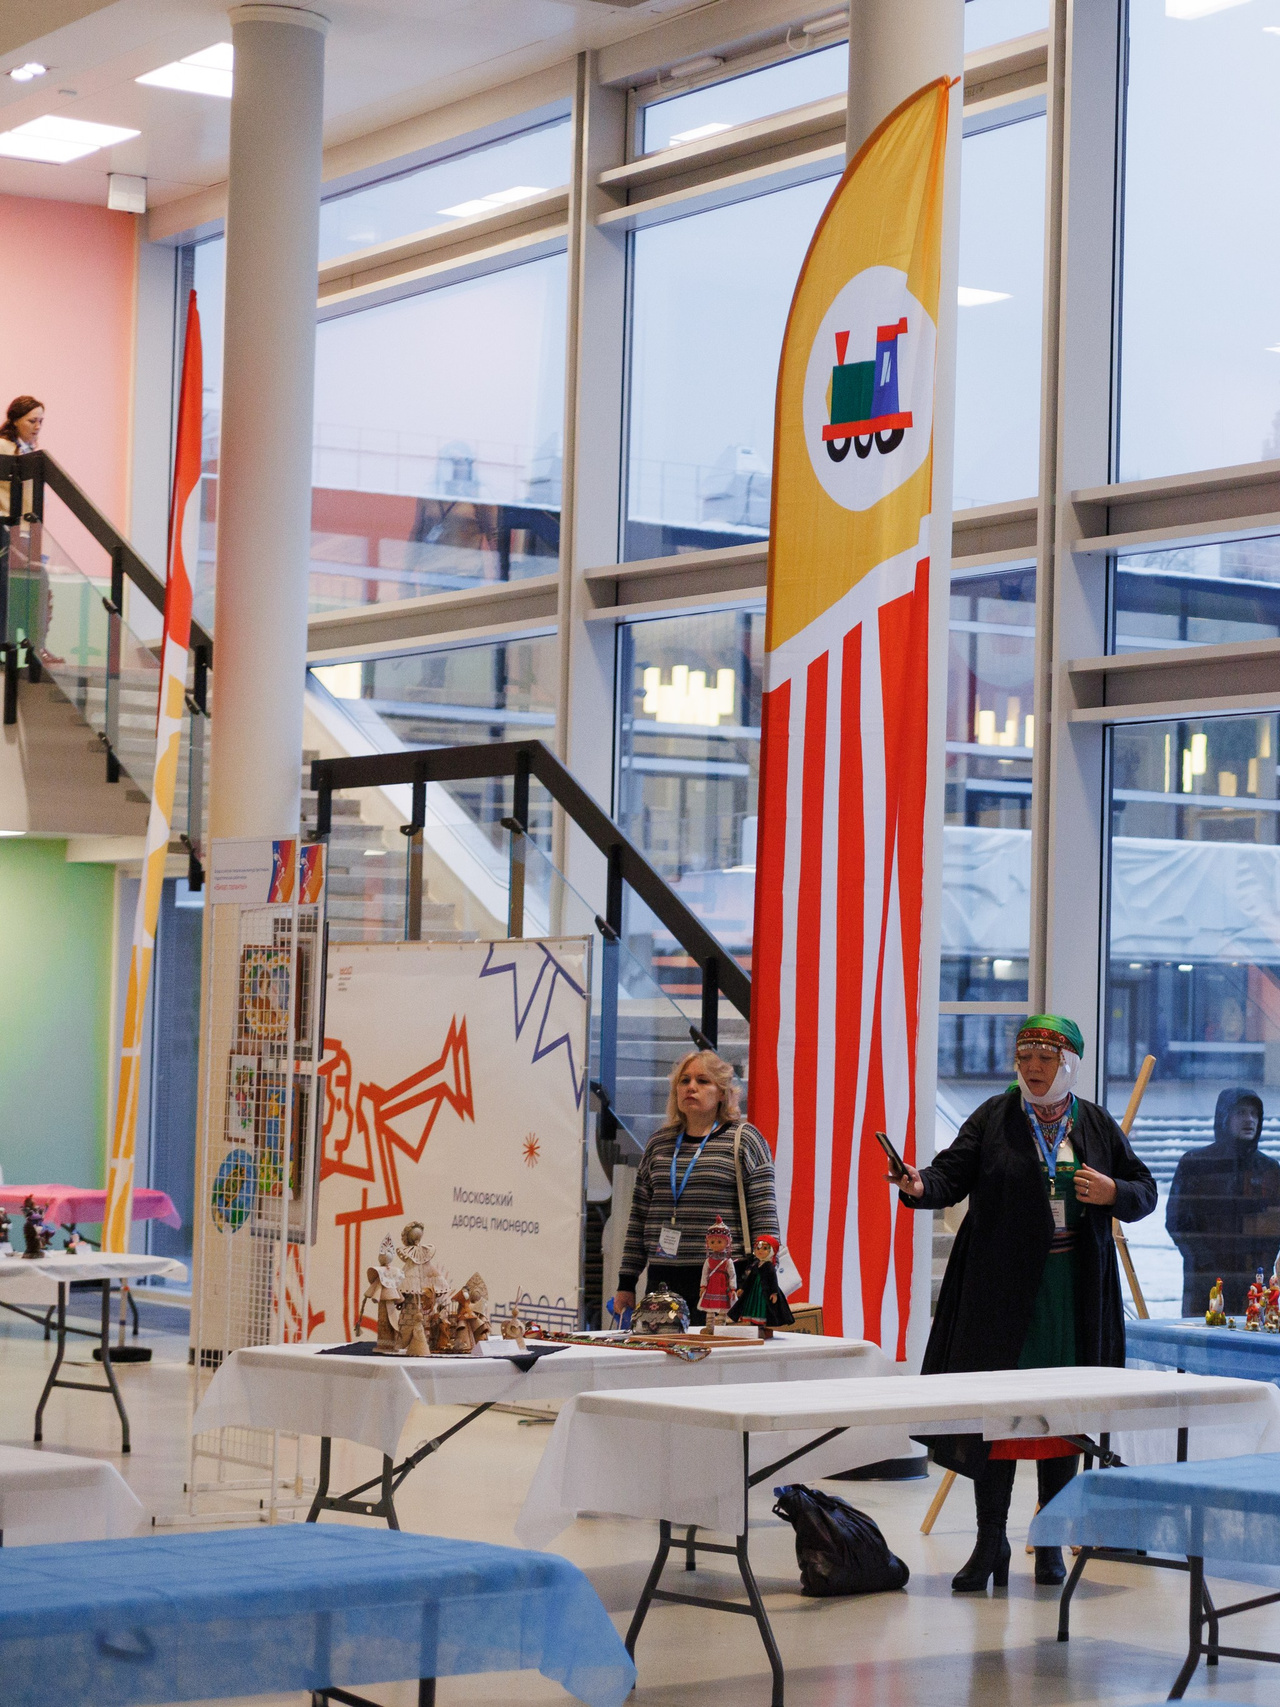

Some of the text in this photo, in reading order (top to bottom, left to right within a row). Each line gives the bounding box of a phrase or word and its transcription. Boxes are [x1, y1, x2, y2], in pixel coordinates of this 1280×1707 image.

[453, 1186, 514, 1206] Московский
[452, 1214, 540, 1236] дворец пионеров
